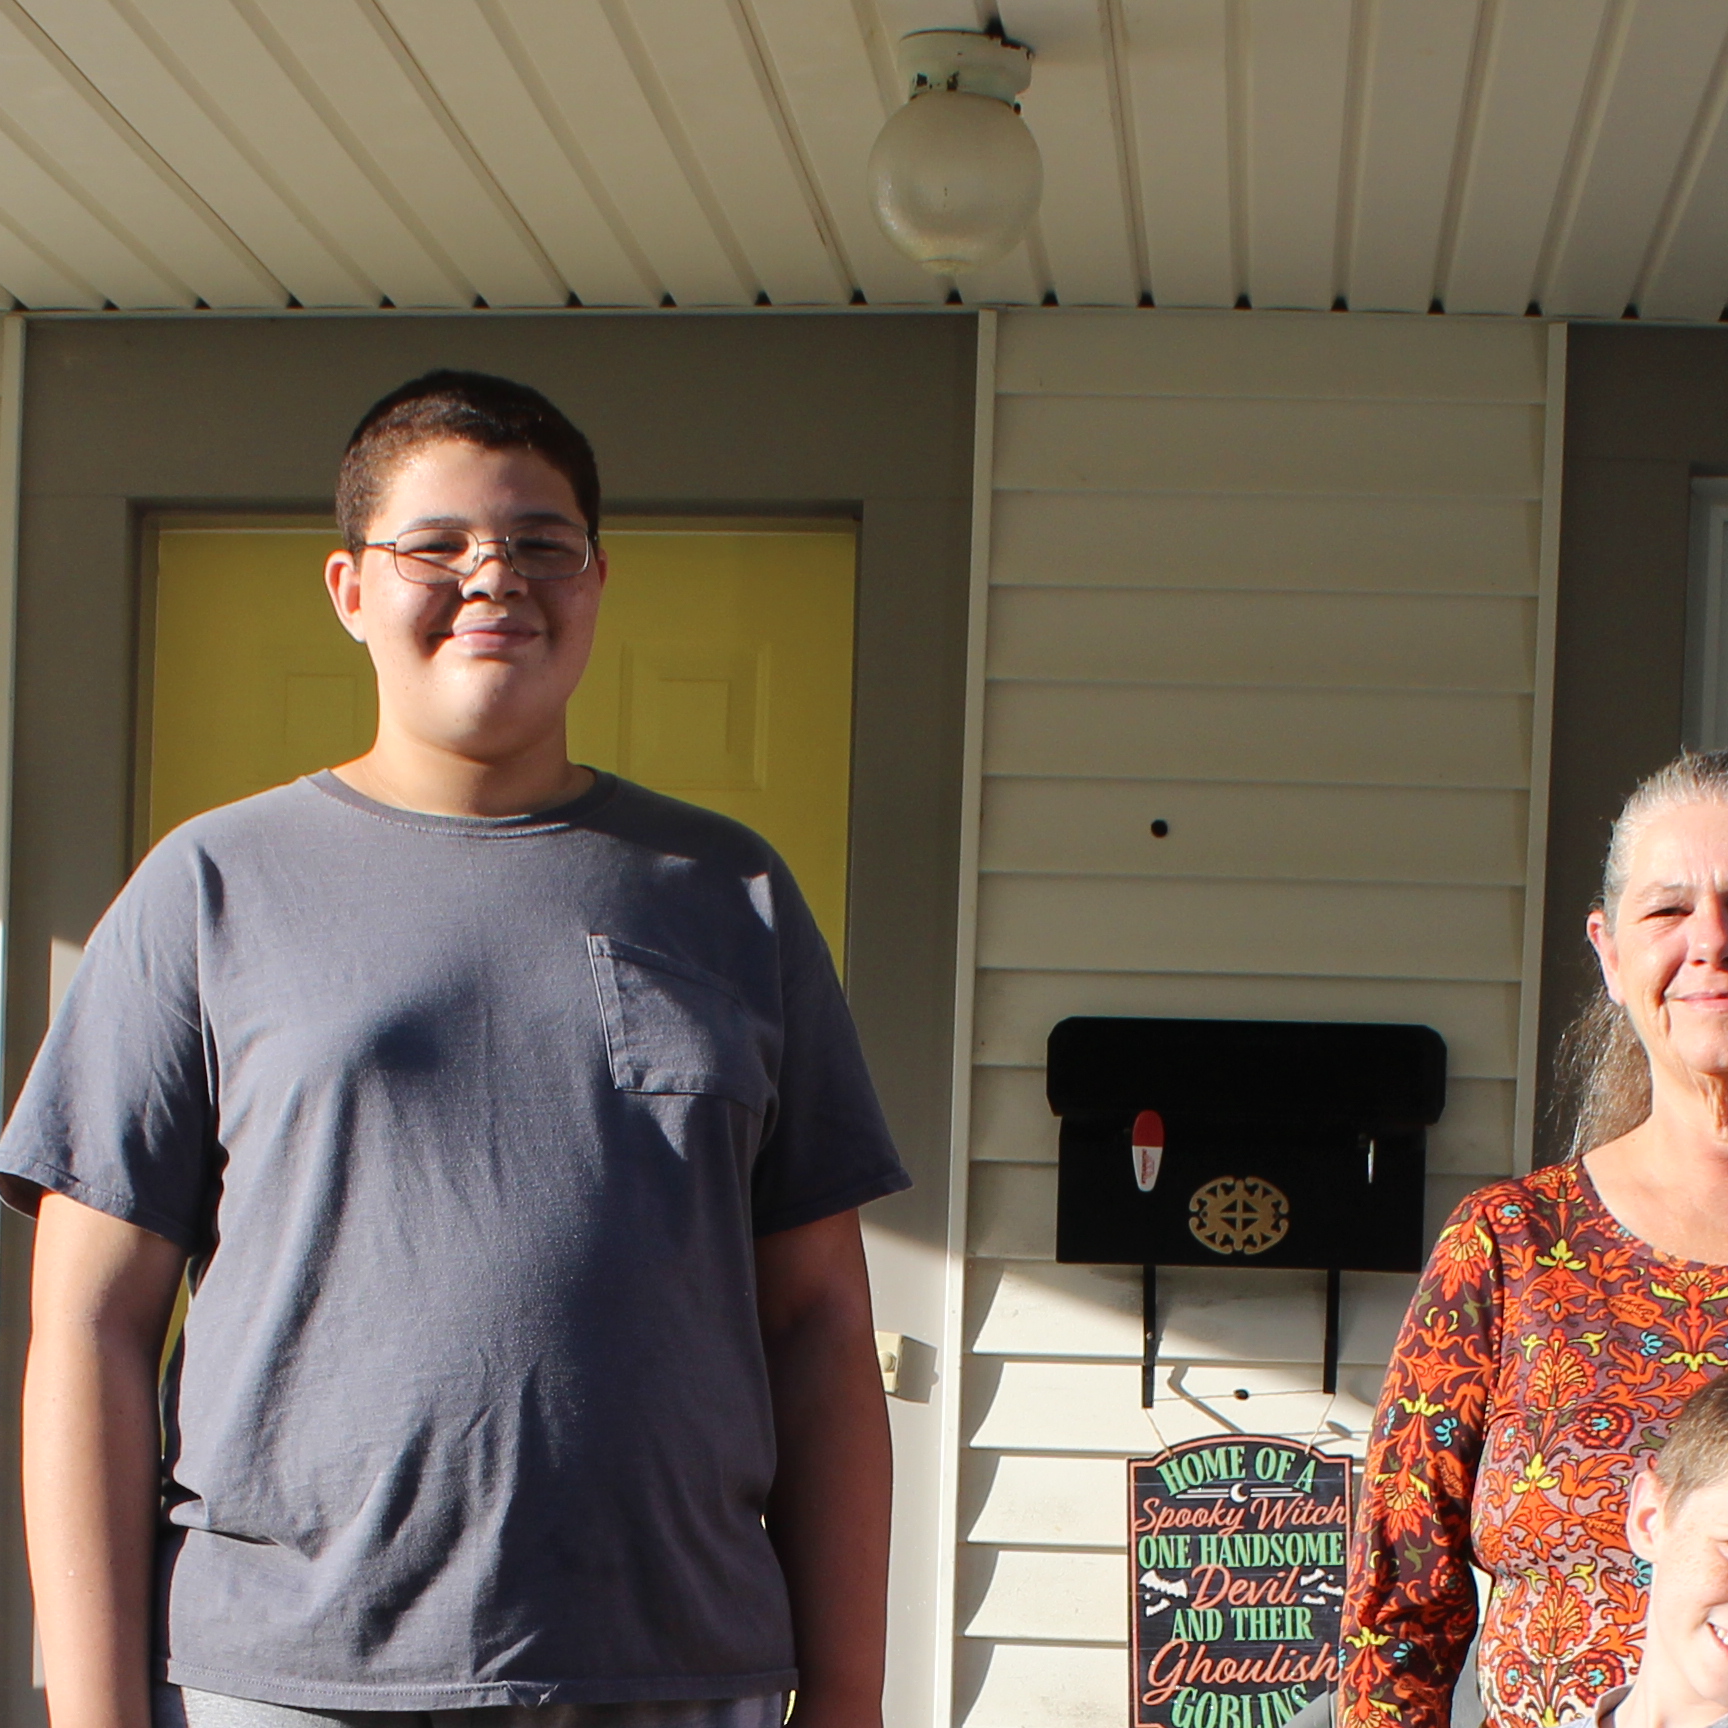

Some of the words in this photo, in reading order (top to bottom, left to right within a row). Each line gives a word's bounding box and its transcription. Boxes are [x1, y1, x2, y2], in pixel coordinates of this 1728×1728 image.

[1156, 1446, 1247, 1496] HOME
[1254, 1446, 1297, 1484] OF
[1293, 1458, 1318, 1494] A
[1135, 1497, 1247, 1536] Spooky
[1250, 1496, 1347, 1531] Witch
[1138, 1534, 1193, 1569] ONE
[1198, 1532, 1345, 1569] HANDSOME
[1190, 1564, 1301, 1610] Devil
[1171, 1607, 1223, 1642] AND
[1230, 1606, 1314, 1642] THEIR
[1142, 1638, 1340, 1706] Ghoulish
